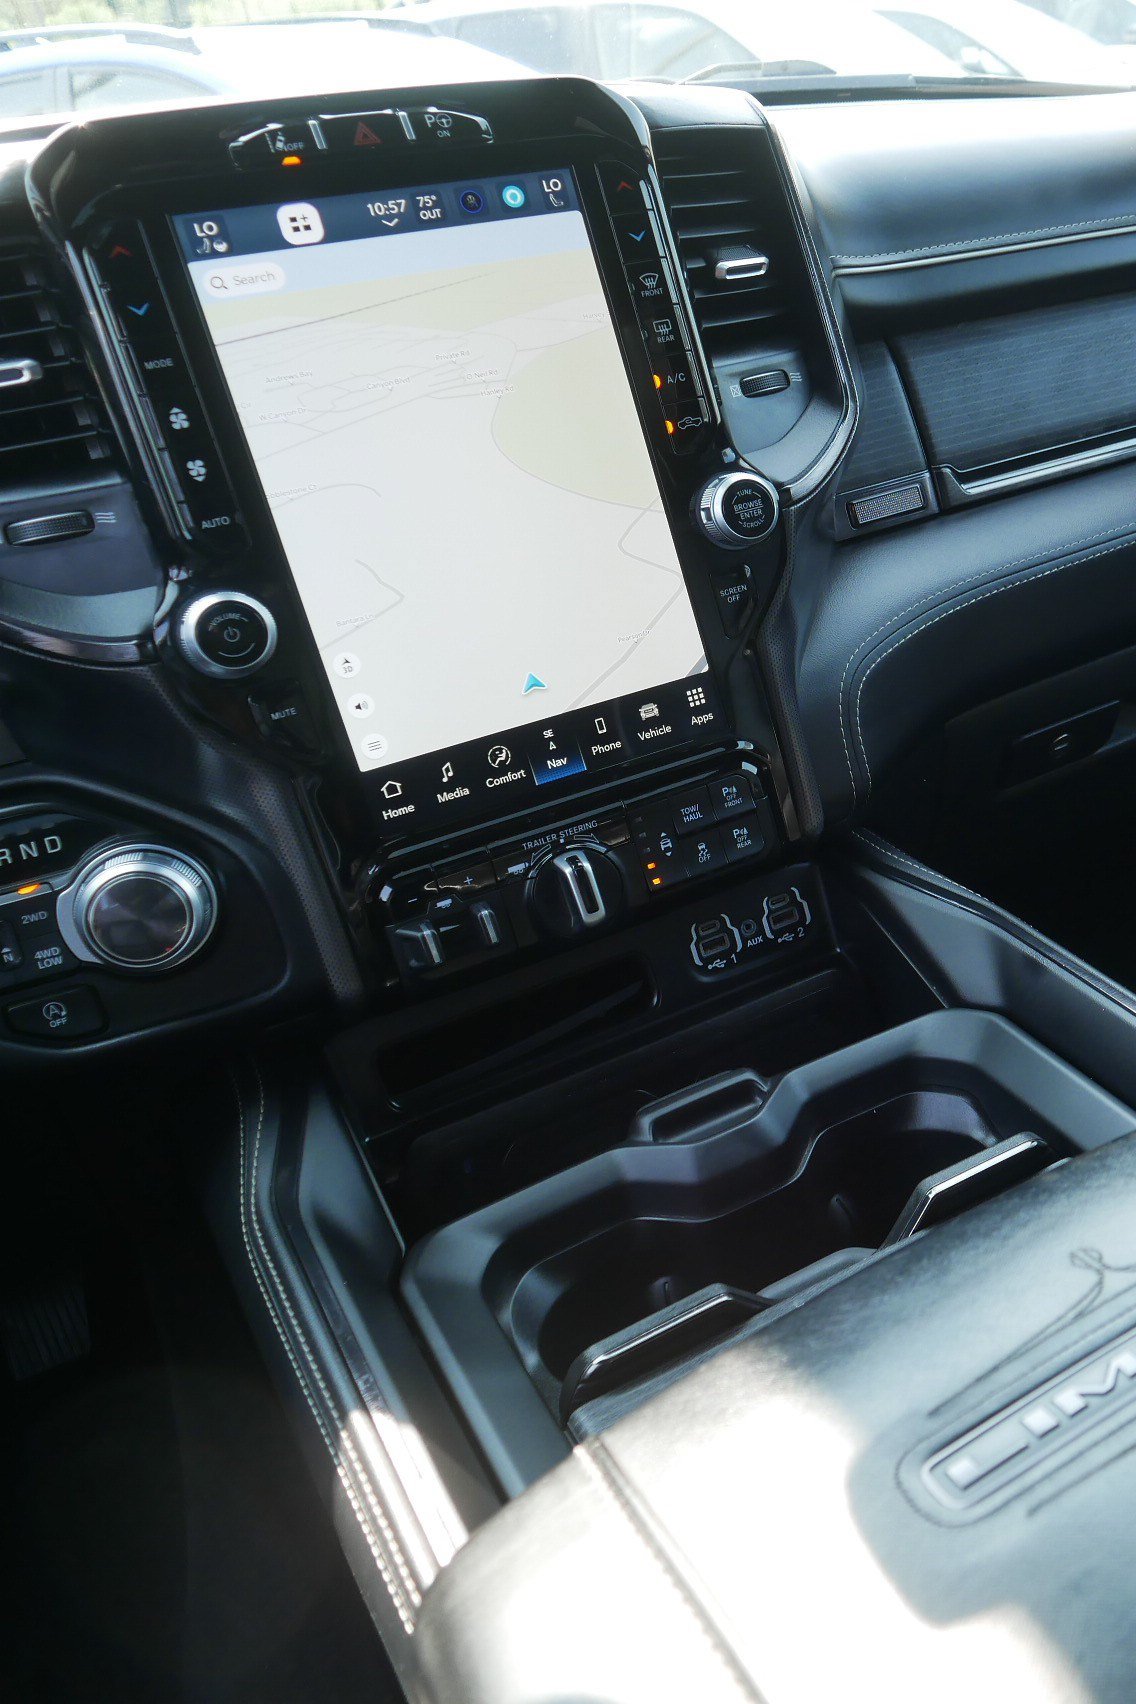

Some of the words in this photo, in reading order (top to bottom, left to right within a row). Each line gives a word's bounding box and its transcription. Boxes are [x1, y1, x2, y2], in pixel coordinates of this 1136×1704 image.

[436, 129, 451, 138] ON
[286, 142, 304, 151] OFF
[543, 178, 562, 193] LO
[367, 199, 406, 217] 10:57
[419, 208, 442, 220] OUT
[193, 221, 219, 238] LO
[233, 270, 276, 287] Search
[640, 287, 664, 298] FRONT
[657, 334, 675, 344] REAR
[143, 358, 174, 370] MODE
[666, 372, 686, 385] A/C
[736, 490, 753, 499] TUNE
[733, 498, 763, 512] BROWSE
[739, 508, 763, 520] ENTER
[201, 516, 231, 530] AUTO
[742, 518, 764, 529] SCROLL
[719, 584, 748, 597] SCREEN
[727, 594, 741, 603] OFF
[210, 612, 242, 626] VOLUME
[343, 665, 354, 674] 3D
[270, 707, 297, 721] MUTE
[691, 711, 714, 726] Apps
[542, 729, 554, 739] SE
[637, 724, 673, 742] Vehicle
[591, 740, 622, 756] Phone
[546, 756, 568, 770] Nav
[485, 768, 526, 789] Comfort
[436, 786, 470, 804] Media
[726, 793, 737, 801] OFF
[680, 803, 700, 816] TOW/
[724, 797, 744, 809] FRONT
[382, 804, 415, 821] Home
[683, 811, 704, 823] HAUL
[522, 834, 557, 851] TRAILER
[559, 820, 599, 841] STEERING
[19, 841, 39, 860] N
[44, 836, 62, 854] D
[736, 839, 752, 850] REAR
[698, 854, 711, 863] OFF
[21, 911, 48, 924] 2WD
[797, 927, 805, 938] 2
[747, 935, 763, 948] AUX
[34, 947, 61, 961] 4WD
[730, 954, 737, 964] 1
[38, 956, 63, 970] LOW
[50, 1017, 68, 1028] OFF
